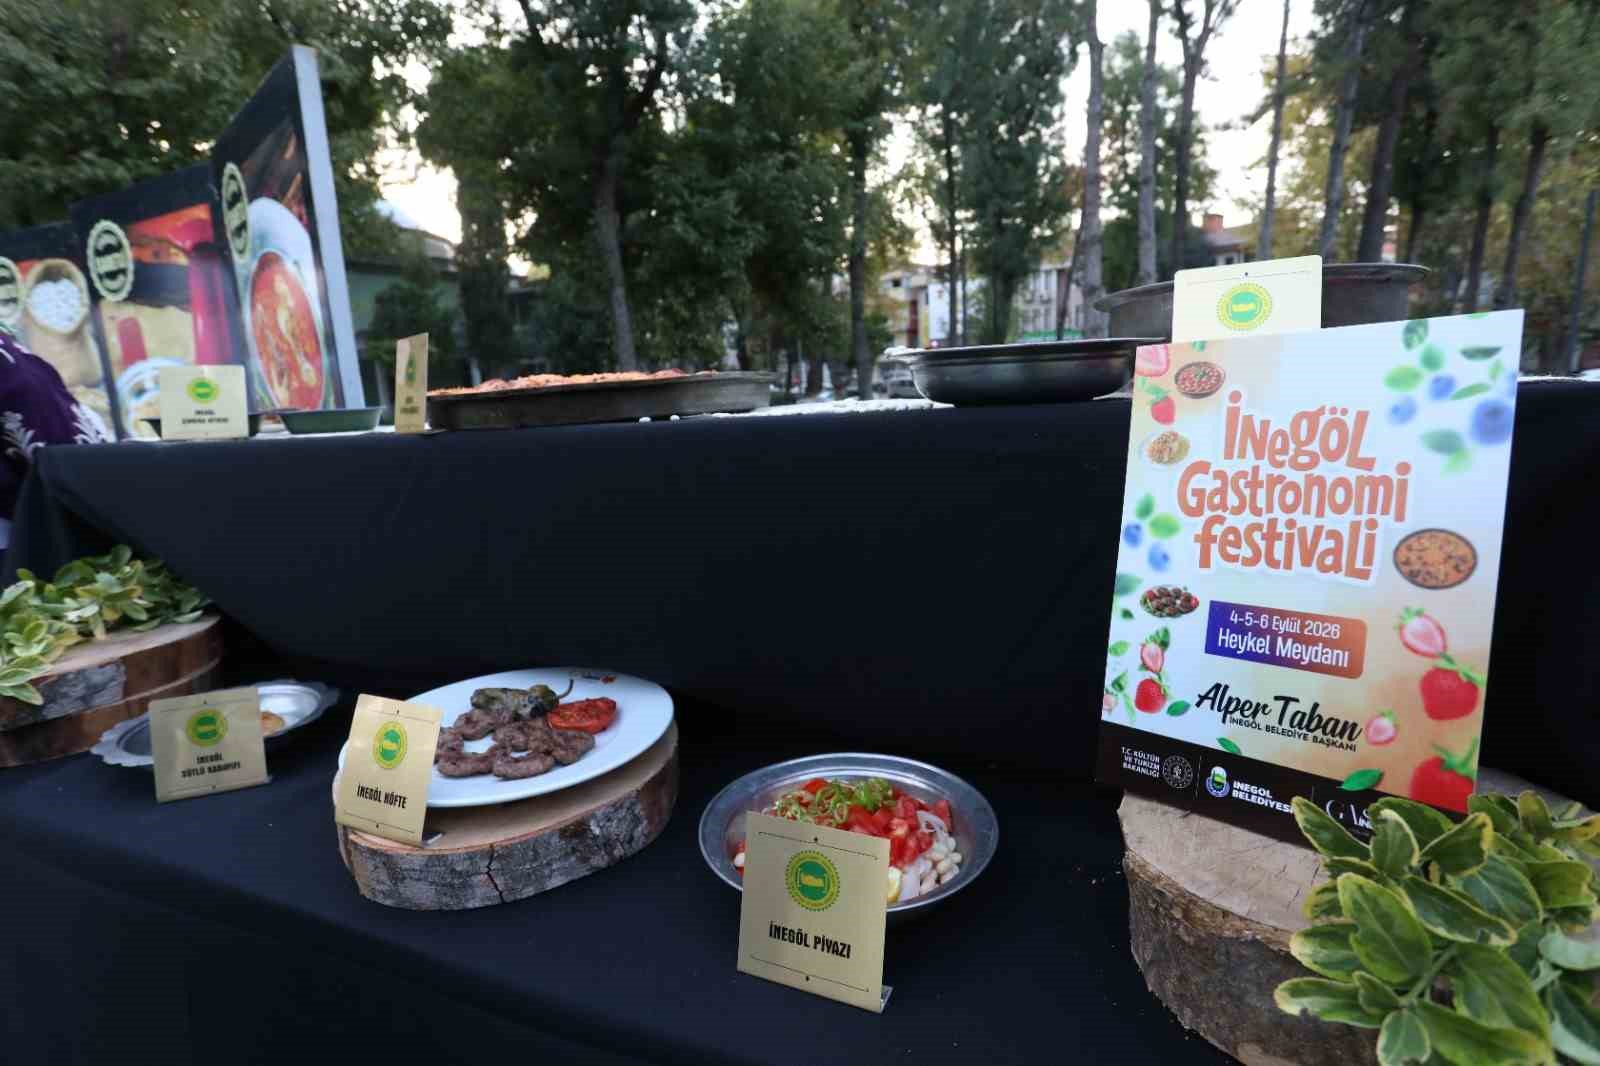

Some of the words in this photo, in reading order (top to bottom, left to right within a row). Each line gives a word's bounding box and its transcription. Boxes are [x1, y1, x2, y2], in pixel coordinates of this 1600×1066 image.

[1177, 460, 1411, 523] Gastronomi
[1230, 610, 1269, 629] 4-5-6
[1272, 616, 1301, 635] Eylül
[1218, 627, 1270, 655] Heykel
[1276, 637, 1349, 668] Meydanı
[1195, 682, 1272, 725] Alper
[1274, 695, 1363, 741] Taban
[1229, 716, 1262, 731] İNEGÖL
[1265, 724, 1309, 742] BELEDİYE
[1312, 735, 1357, 752] BAŞKANI
[383, 792, 408, 809] KÖFTE
[769, 920, 810, 948] İNEGÖL
[813, 934, 852, 959] PİYAZI
